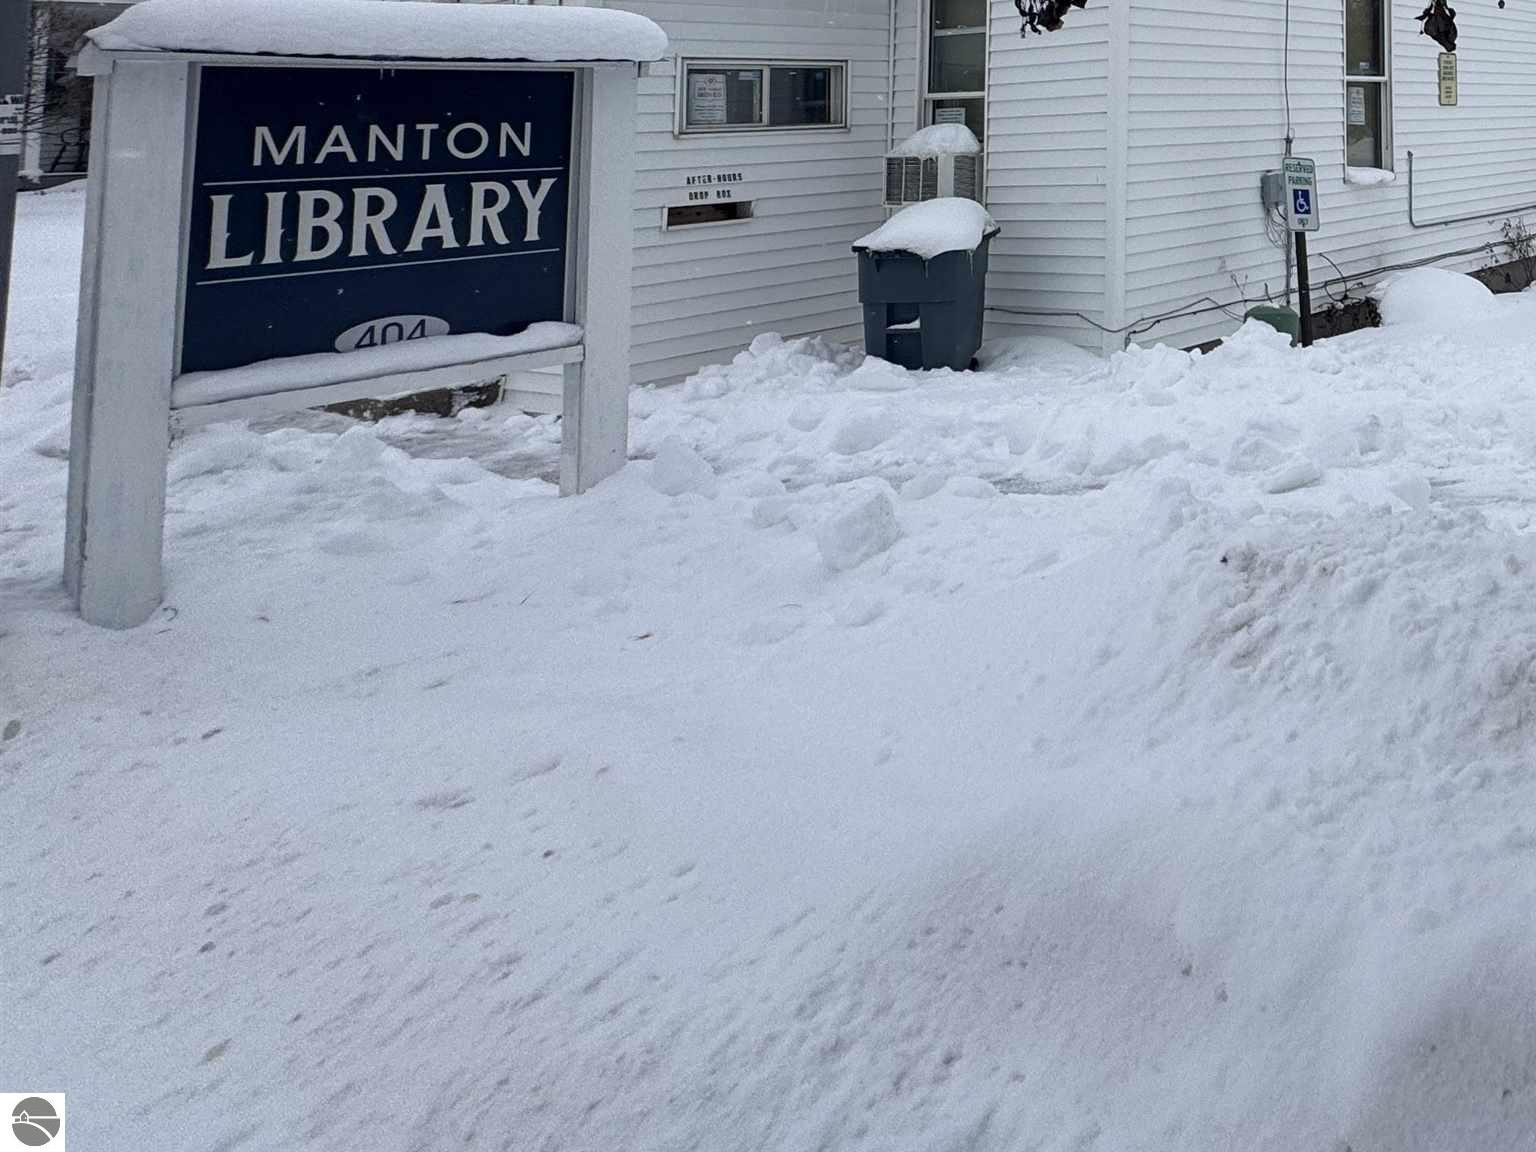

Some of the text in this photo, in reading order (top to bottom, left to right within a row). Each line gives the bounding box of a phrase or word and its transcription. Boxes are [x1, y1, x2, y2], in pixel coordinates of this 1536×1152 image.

[253, 122, 531, 166] MANTON
[1285, 163, 1313, 173] RESERVED
[686, 173, 743, 185] AFTER-HOURS
[1287, 176, 1312, 186] PARKING
[688, 189, 732, 201] DROP BOX
[205, 178, 558, 269] LIBRARY
[354, 319, 428, 349] 404
